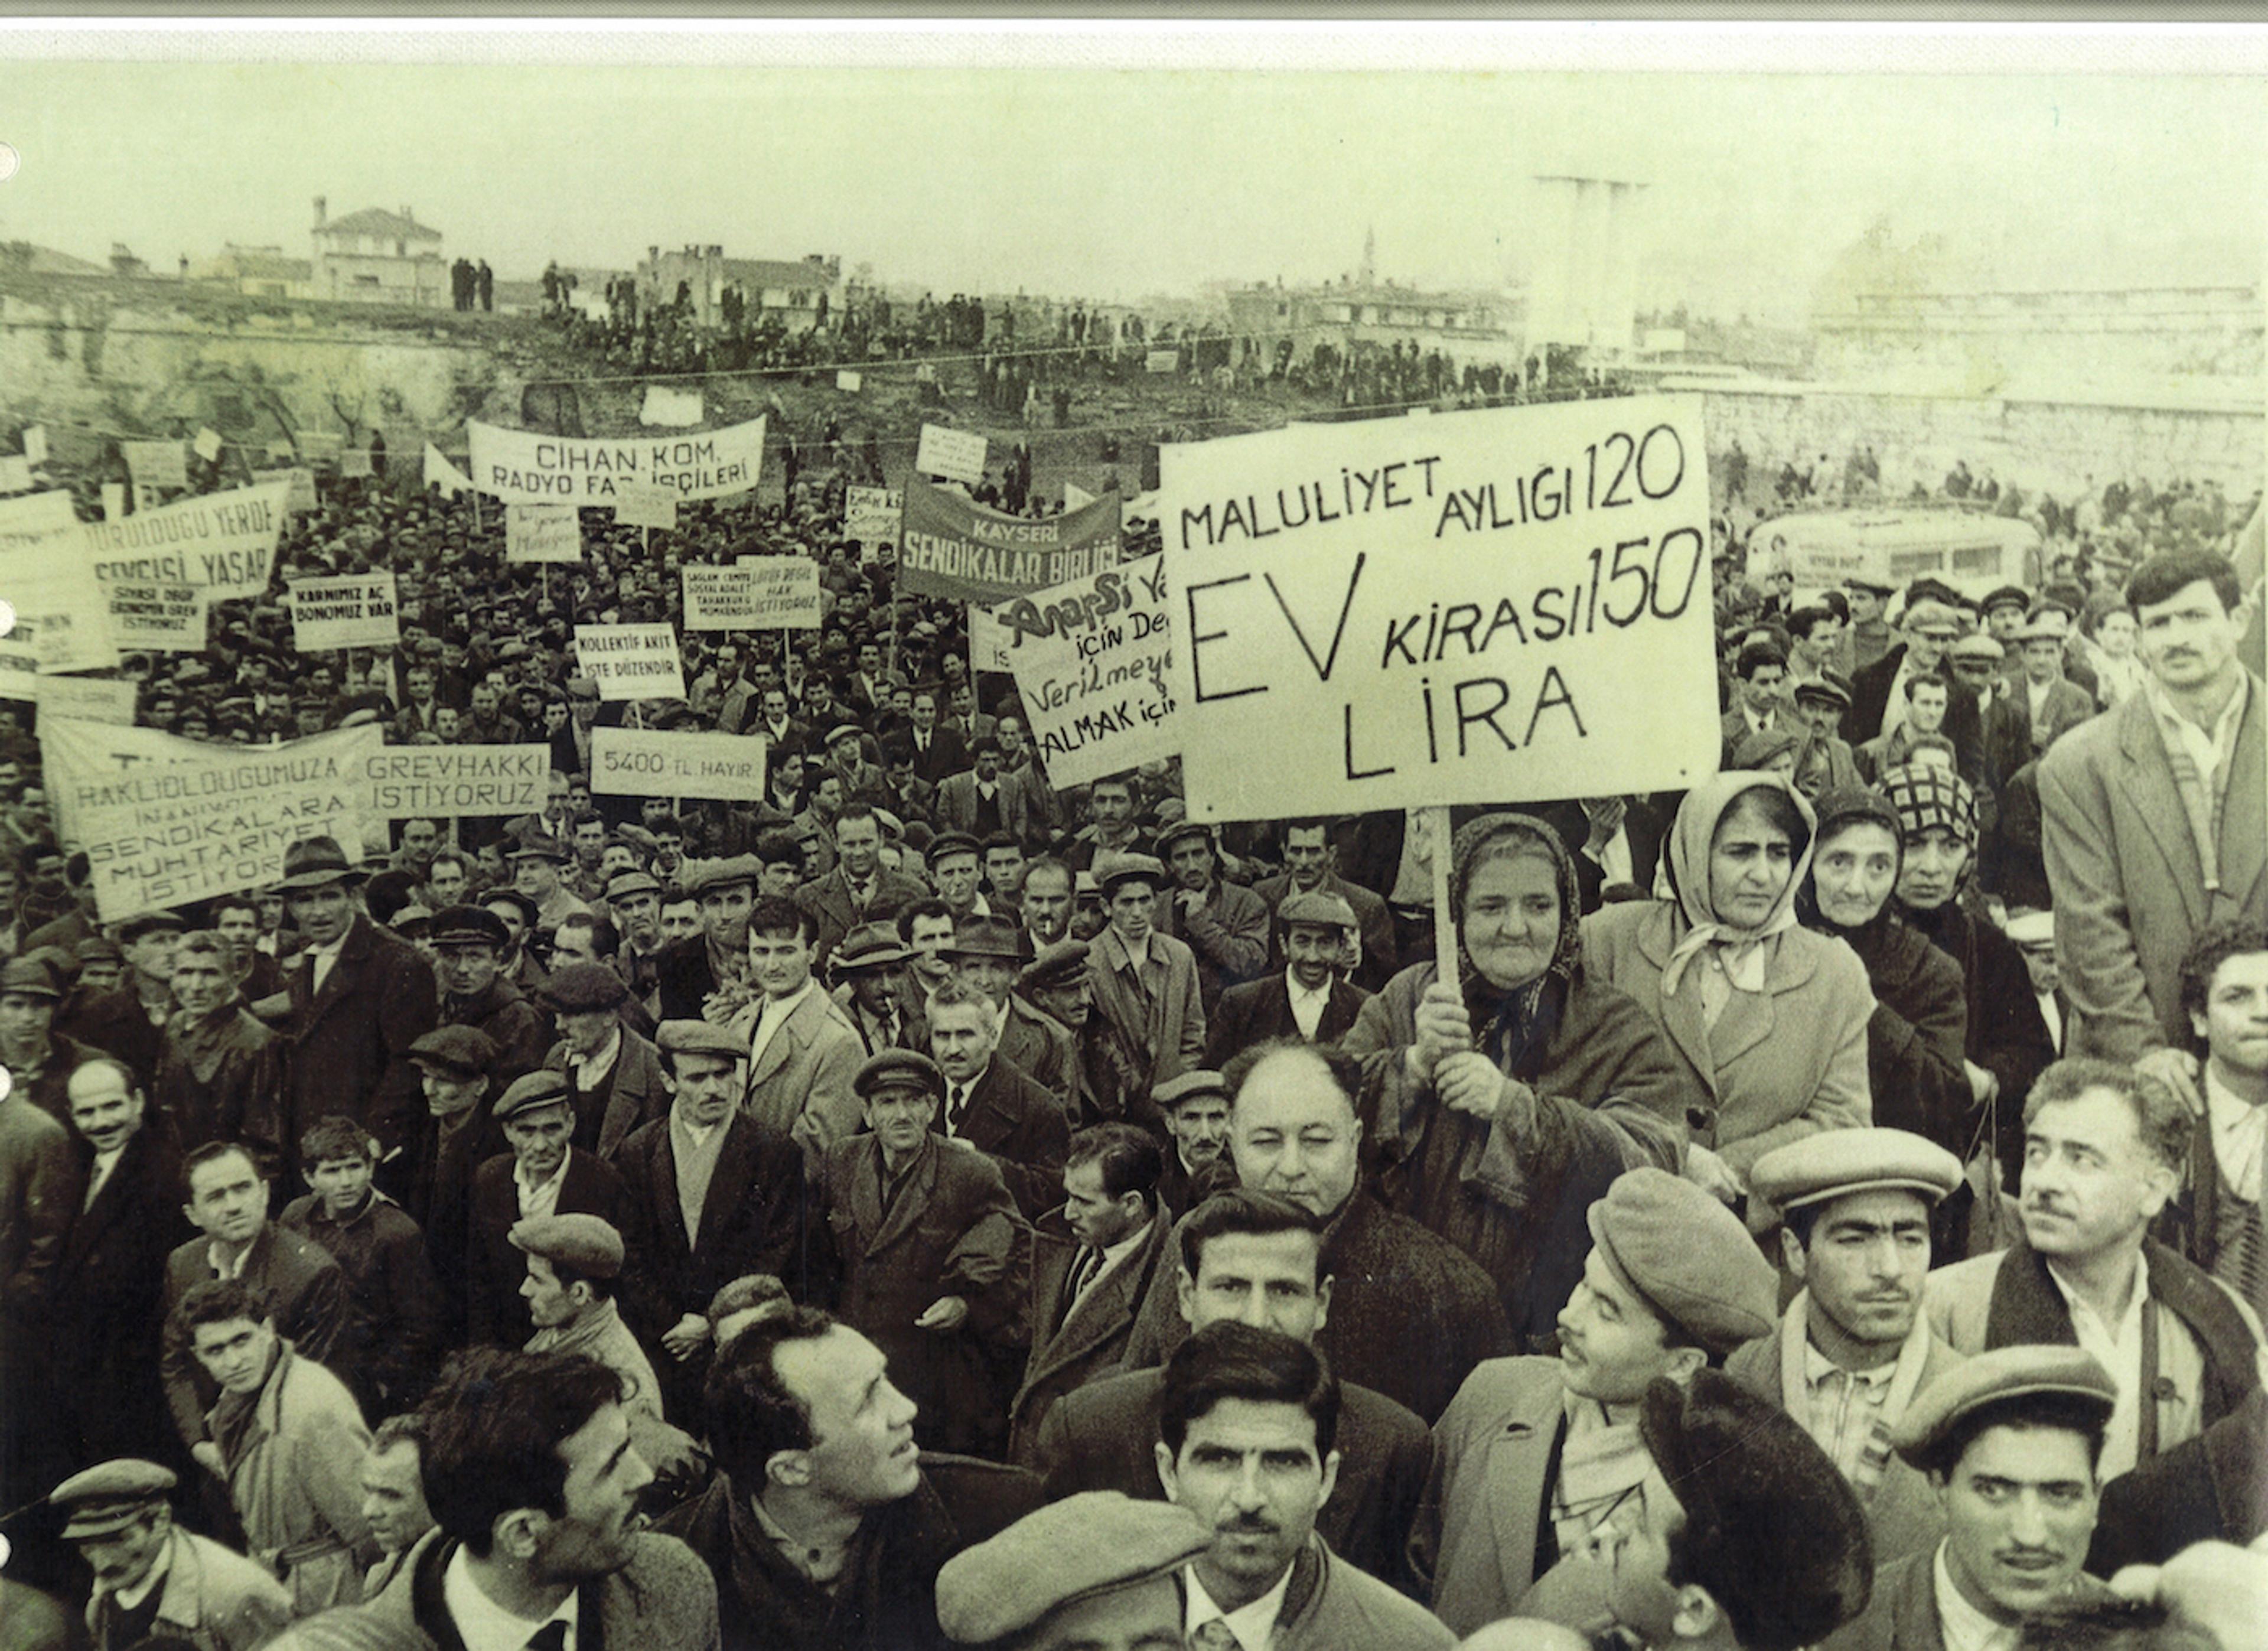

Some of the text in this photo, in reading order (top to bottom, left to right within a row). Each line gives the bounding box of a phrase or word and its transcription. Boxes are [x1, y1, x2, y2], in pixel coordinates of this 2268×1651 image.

[492, 464, 573, 496] RADYO
[1182, 456, 1441, 549] MALULİYET
[1585, 424, 1685, 510] 120
[212, 499, 272, 536] YERDE
[972, 519, 1060, 543] KAYSERİ
[902, 529, 1042, 585] SENDİKALAR
[368, 602, 393, 617] VAR
[1128, 611, 1171, 641] De
[1186, 526, 1703, 704] EV KİRASI 150
[1040, 699, 1136, 763] ALMAK
[1344, 666, 1588, 780] LİRA
[604, 751, 664, 773] 5400
[700, 761, 753, 778] HAYIR
